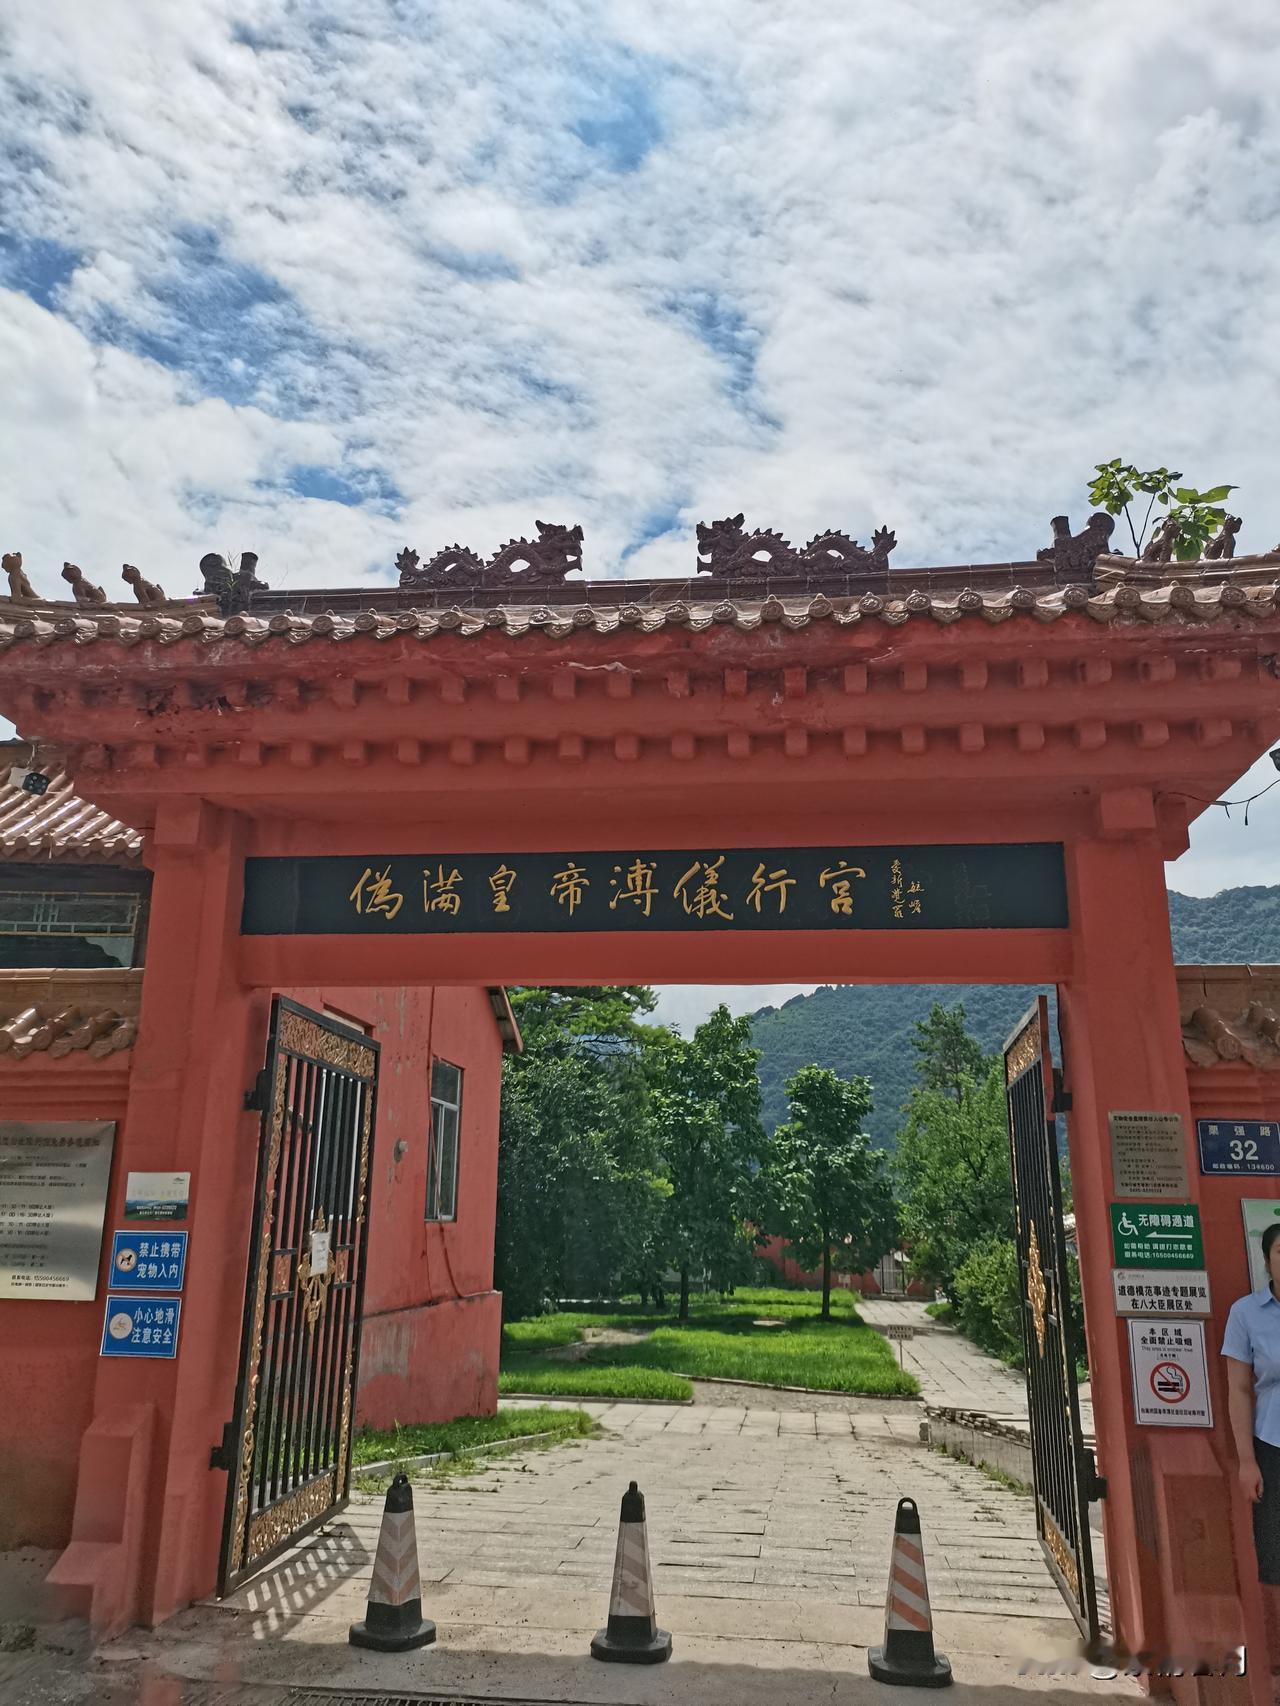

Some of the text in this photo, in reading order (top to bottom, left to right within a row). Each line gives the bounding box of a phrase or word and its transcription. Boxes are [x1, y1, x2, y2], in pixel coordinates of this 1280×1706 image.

[1229, 1140, 1259, 1161] 32
[1138, 1214, 1194, 1228] 无障碍通道
[138, 1242, 181, 1258] 禁止携带
[136, 1263, 179, 1279] 宠物入内
[1118, 1285, 1207, 1298] 道德模范事迹专题展览
[1131, 1298, 1193, 1310] 在八大臣展区处
[133, 1307, 175, 1325] 小心地滑
[130, 1327, 173, 1344] 注意安全
[1149, 1328, 1182, 1337] 本区域
[1141, 1336, 1193, 1346] 全面禁止吸烟
